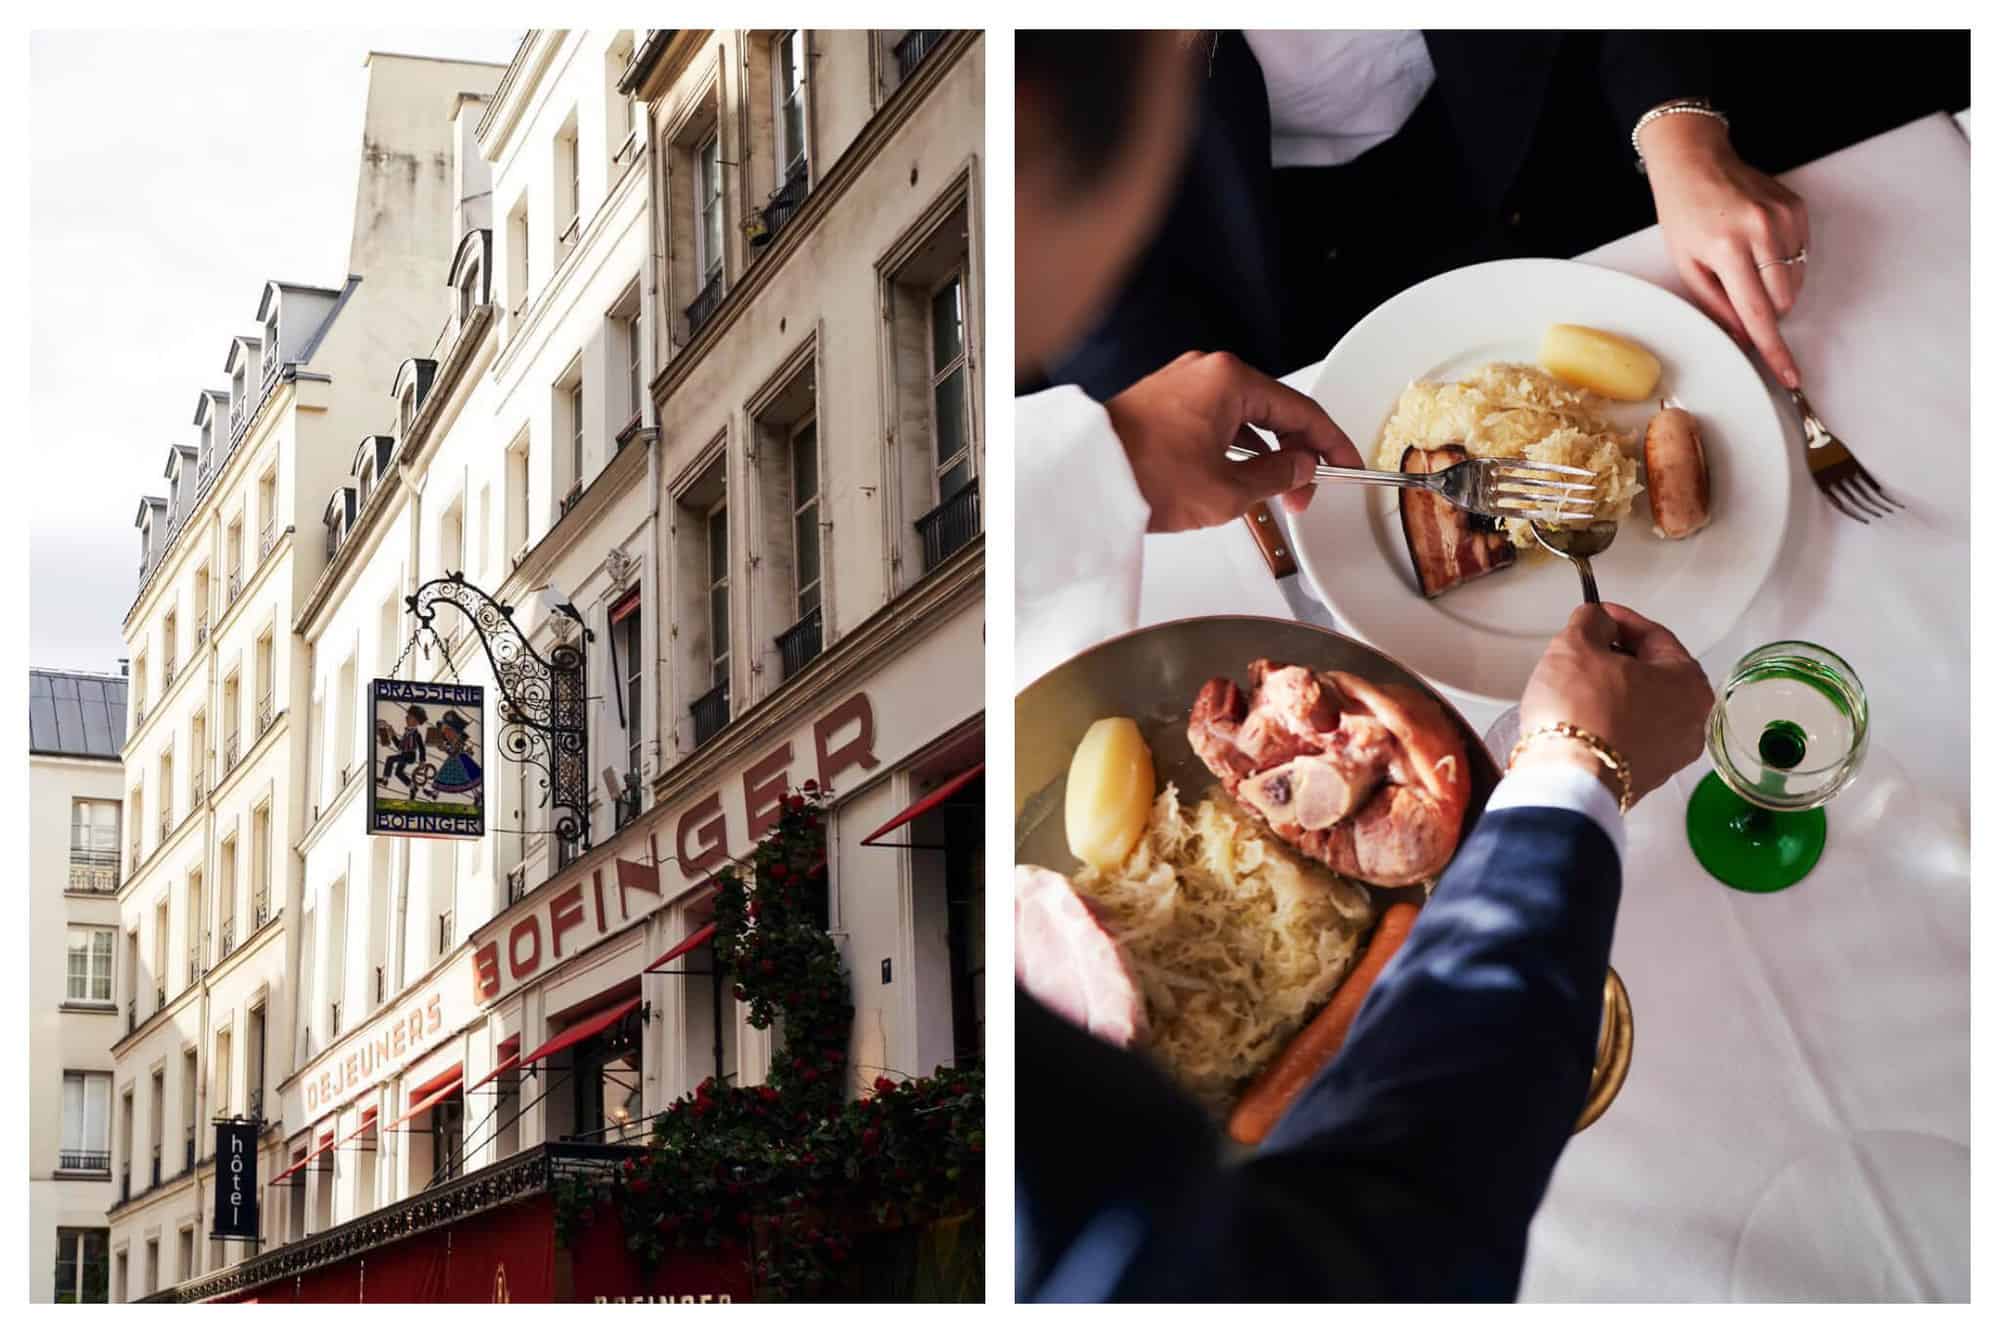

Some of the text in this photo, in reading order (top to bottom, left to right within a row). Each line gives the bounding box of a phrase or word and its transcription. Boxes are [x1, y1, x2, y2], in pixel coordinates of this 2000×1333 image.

[375, 682, 481, 704] BRASSERIE
[376, 812, 481, 833] BOFINGER
[475, 692, 881, 1006] BOFINGER
[306, 992, 443, 1113] DEJEUNERS
[230, 1133, 243, 1226] hôtel
